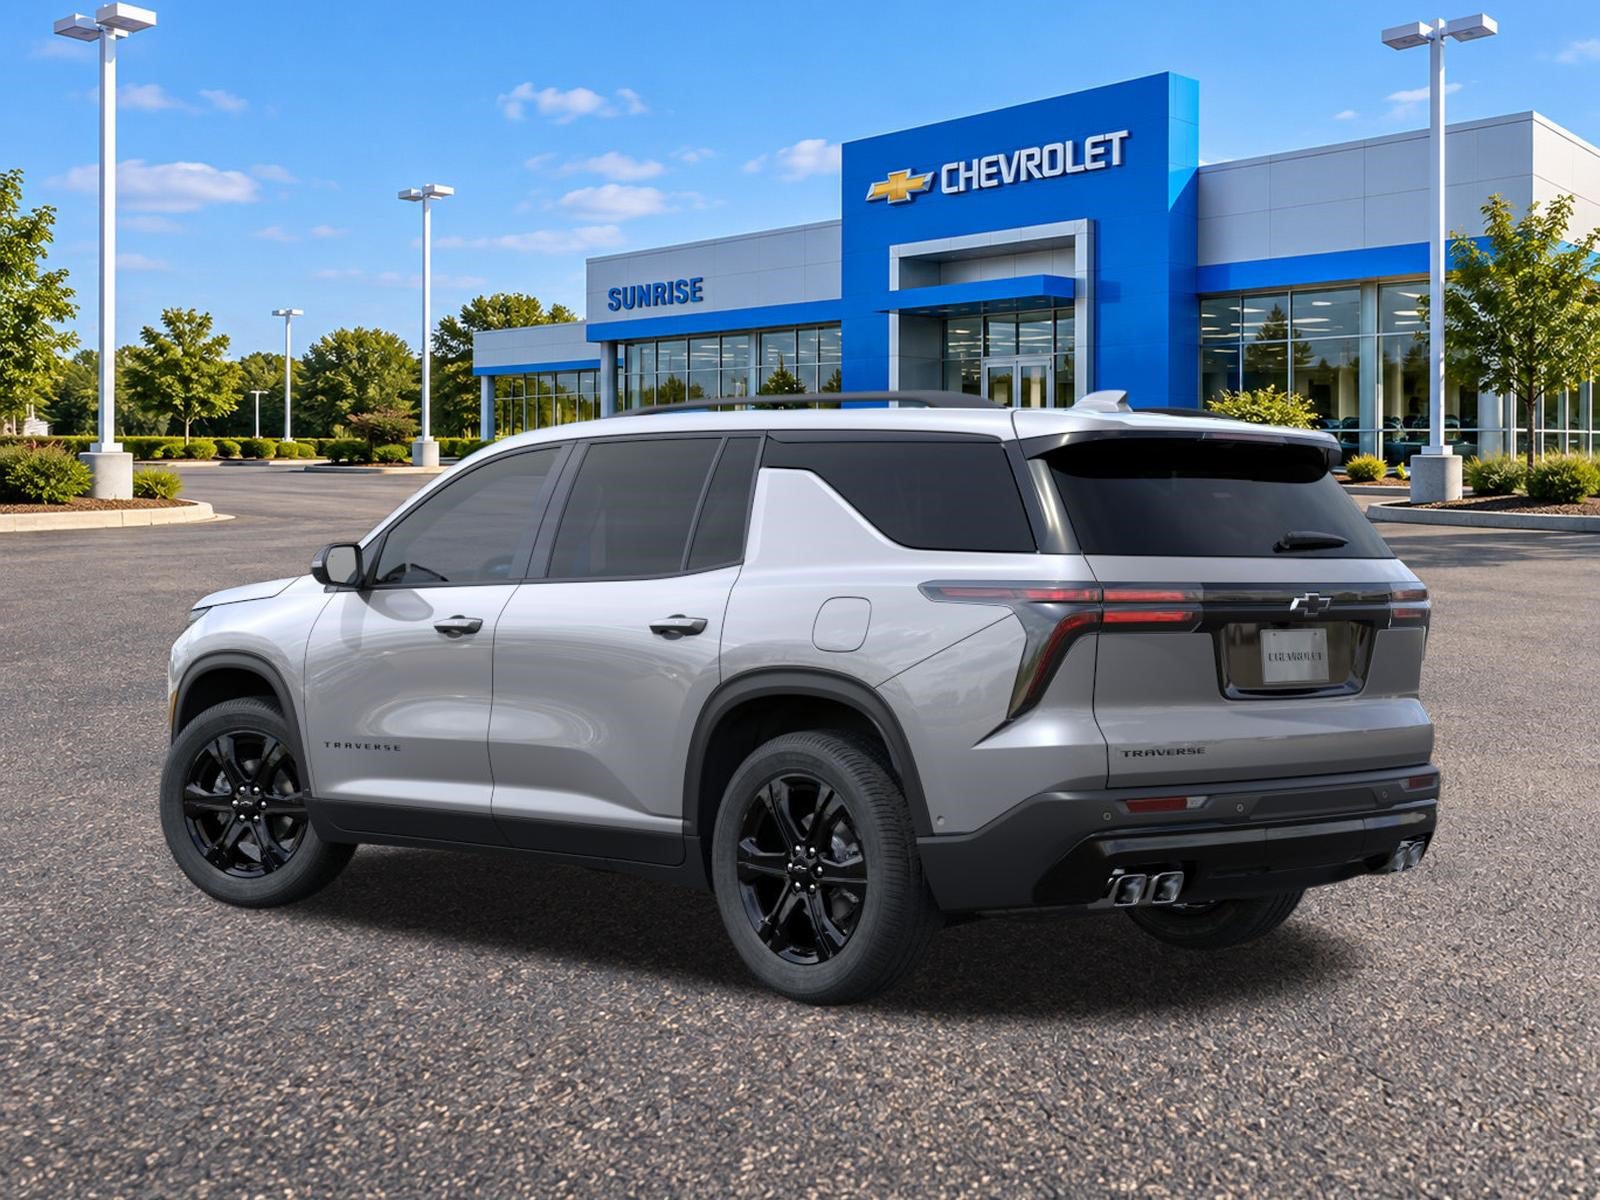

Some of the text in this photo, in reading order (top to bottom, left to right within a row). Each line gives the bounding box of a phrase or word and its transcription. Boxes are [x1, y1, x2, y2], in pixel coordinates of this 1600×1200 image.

[941, 130, 1129, 195] CHEVROLET
[607, 277, 704, 312] SUNRISE
[324, 741, 401, 752] TRAVERSE
[1121, 747, 1206, 758] TRAVERSE
